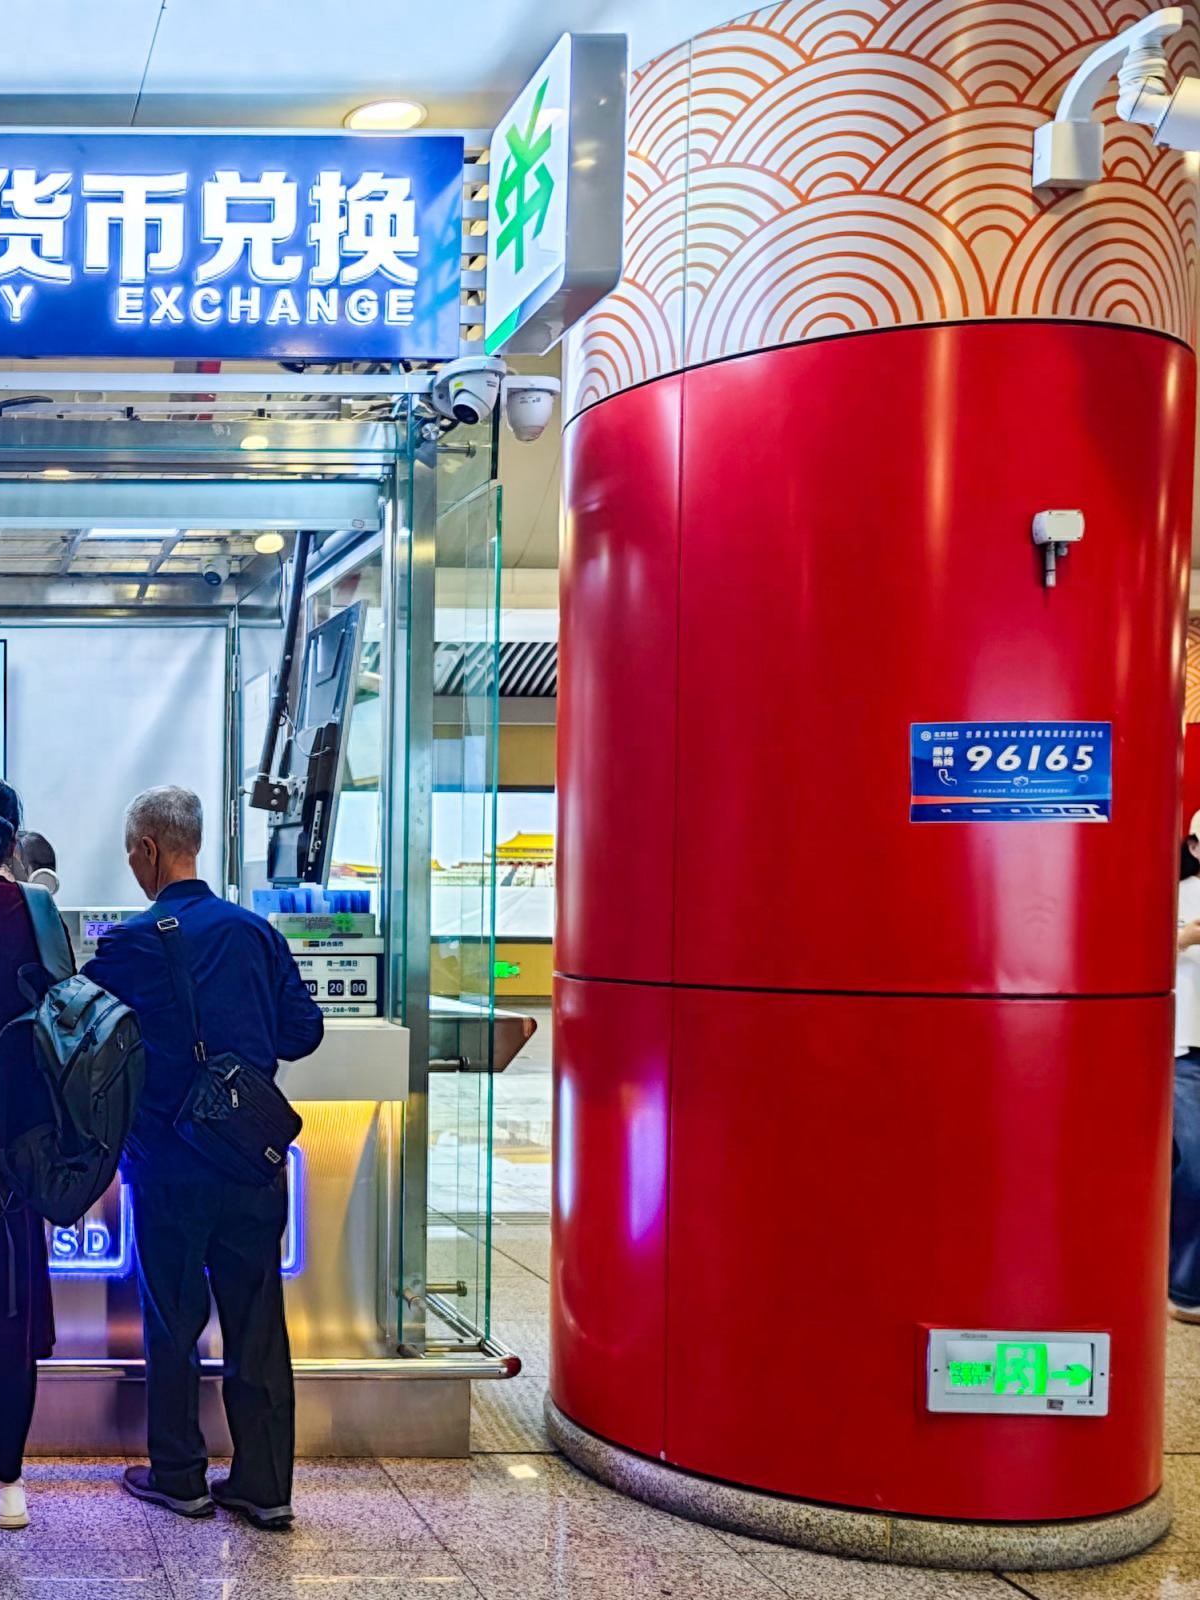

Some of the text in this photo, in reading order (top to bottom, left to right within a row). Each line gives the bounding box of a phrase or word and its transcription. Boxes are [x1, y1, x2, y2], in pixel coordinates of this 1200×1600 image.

[115, 286, 417, 326] EXCHANGE
[966, 745, 1094, 772] 96165
[51, 1225, 111, 1258] SD
